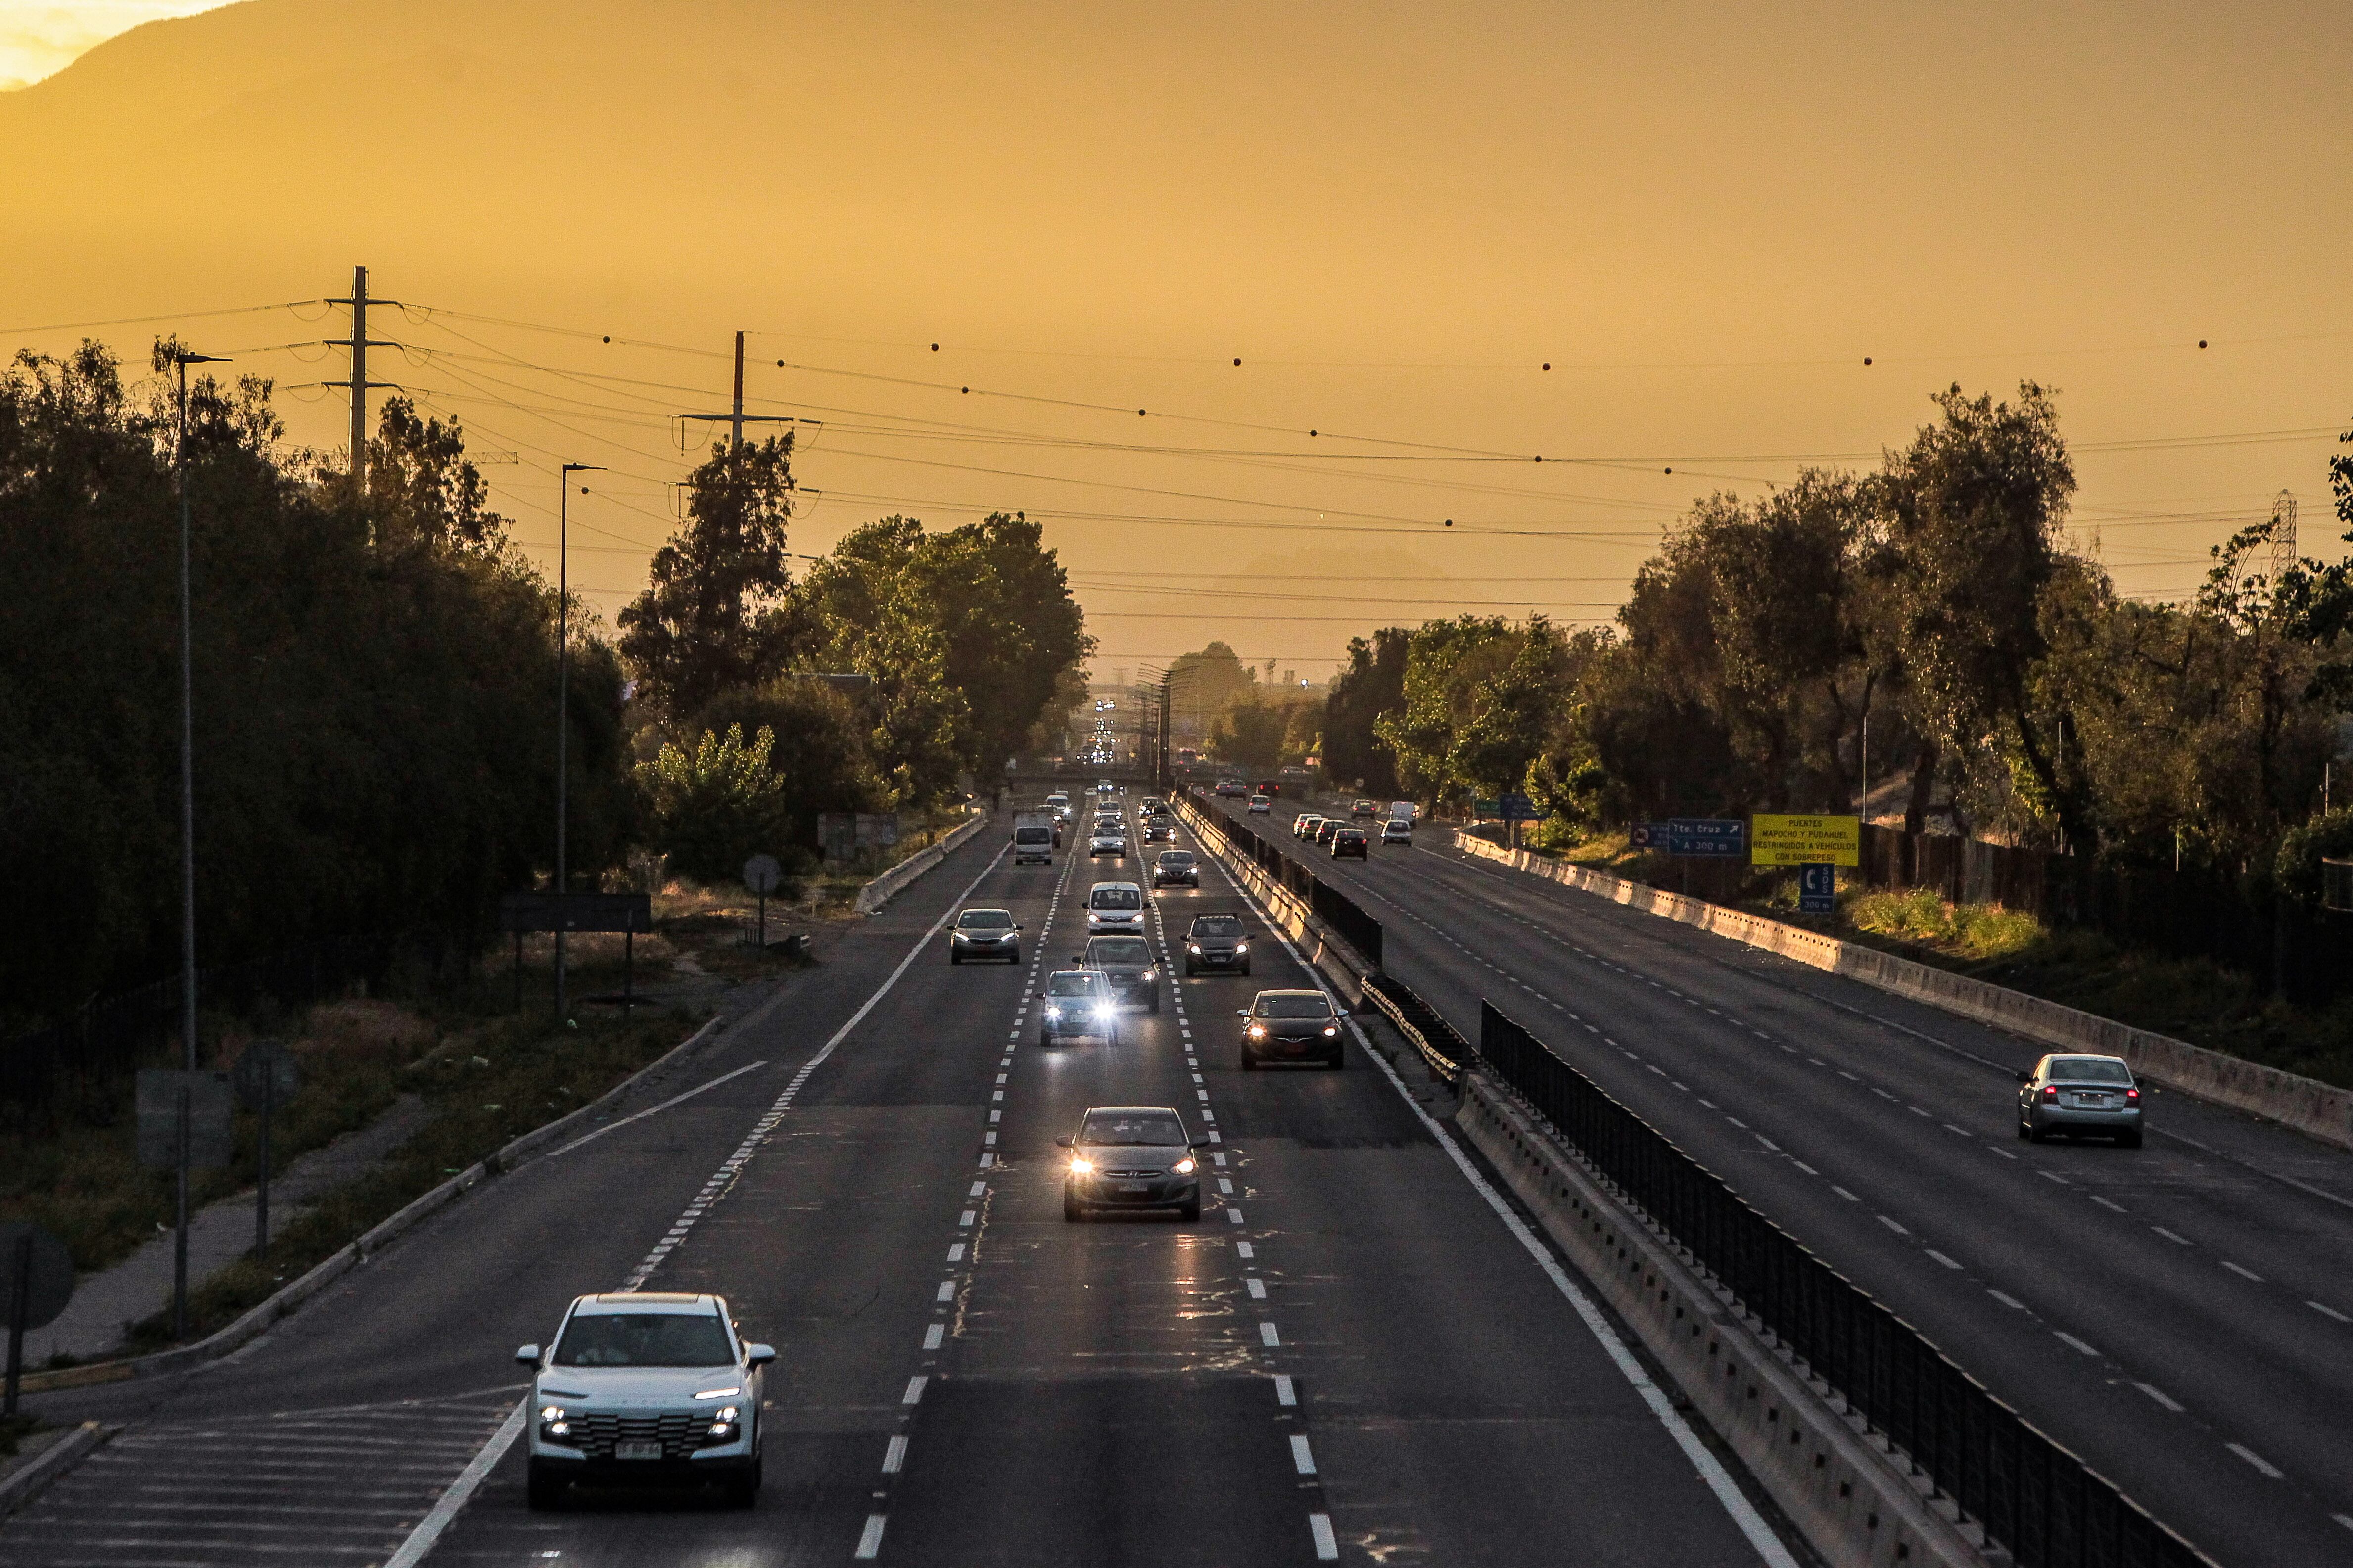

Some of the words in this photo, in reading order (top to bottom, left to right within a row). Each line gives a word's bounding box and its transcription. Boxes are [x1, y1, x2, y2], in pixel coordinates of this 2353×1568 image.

[1697, 825, 1720, 833] Cruz
[1696, 842, 1714, 850] 300
[1753, 841, 1805, 849] RESTRINGIDOS
